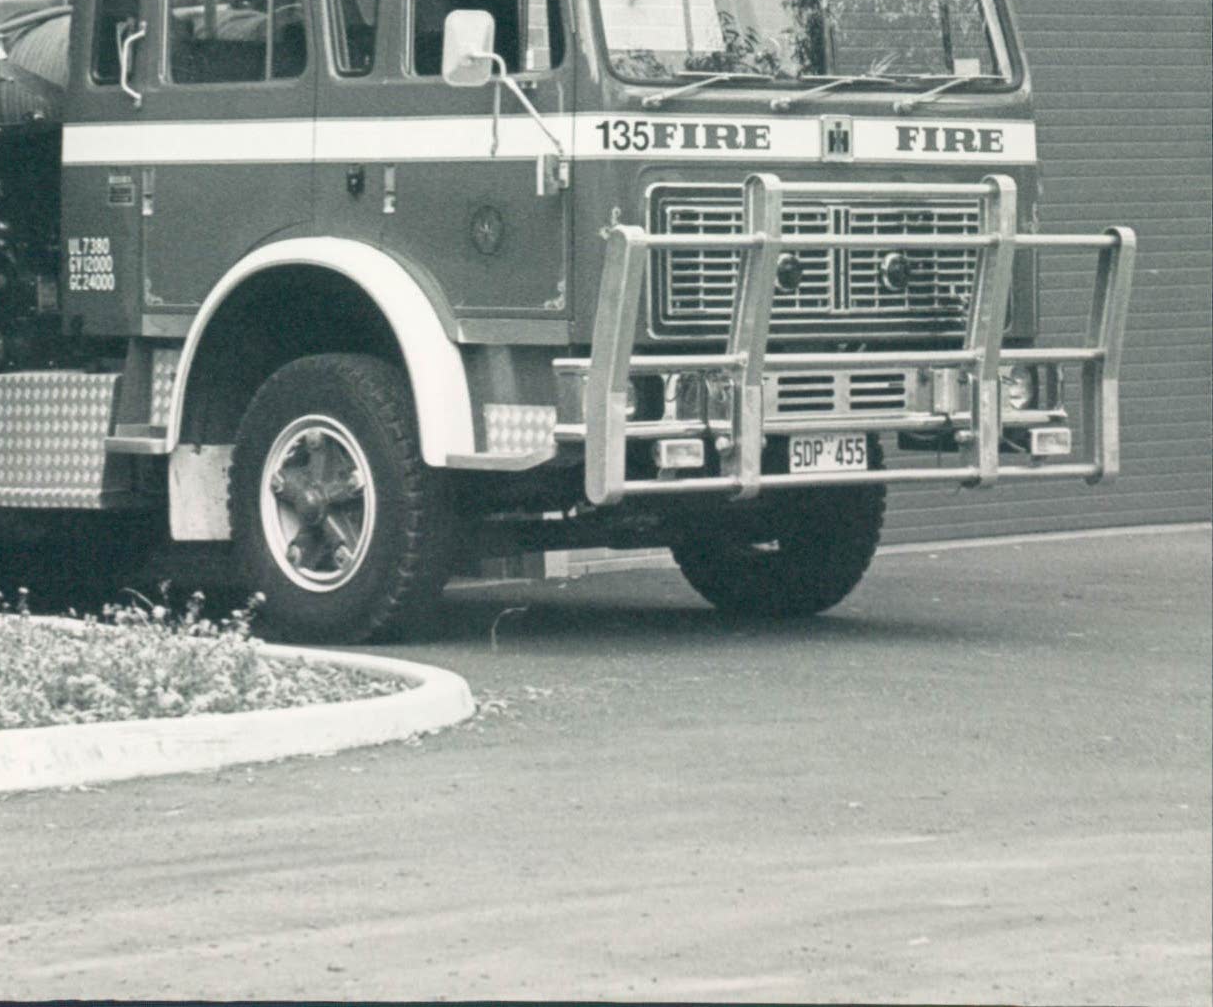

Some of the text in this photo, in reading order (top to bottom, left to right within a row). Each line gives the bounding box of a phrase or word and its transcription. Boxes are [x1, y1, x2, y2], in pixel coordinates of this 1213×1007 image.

[596, 119, 771, 151] 135 FIRE
[895, 125, 1004, 153] FIRE
